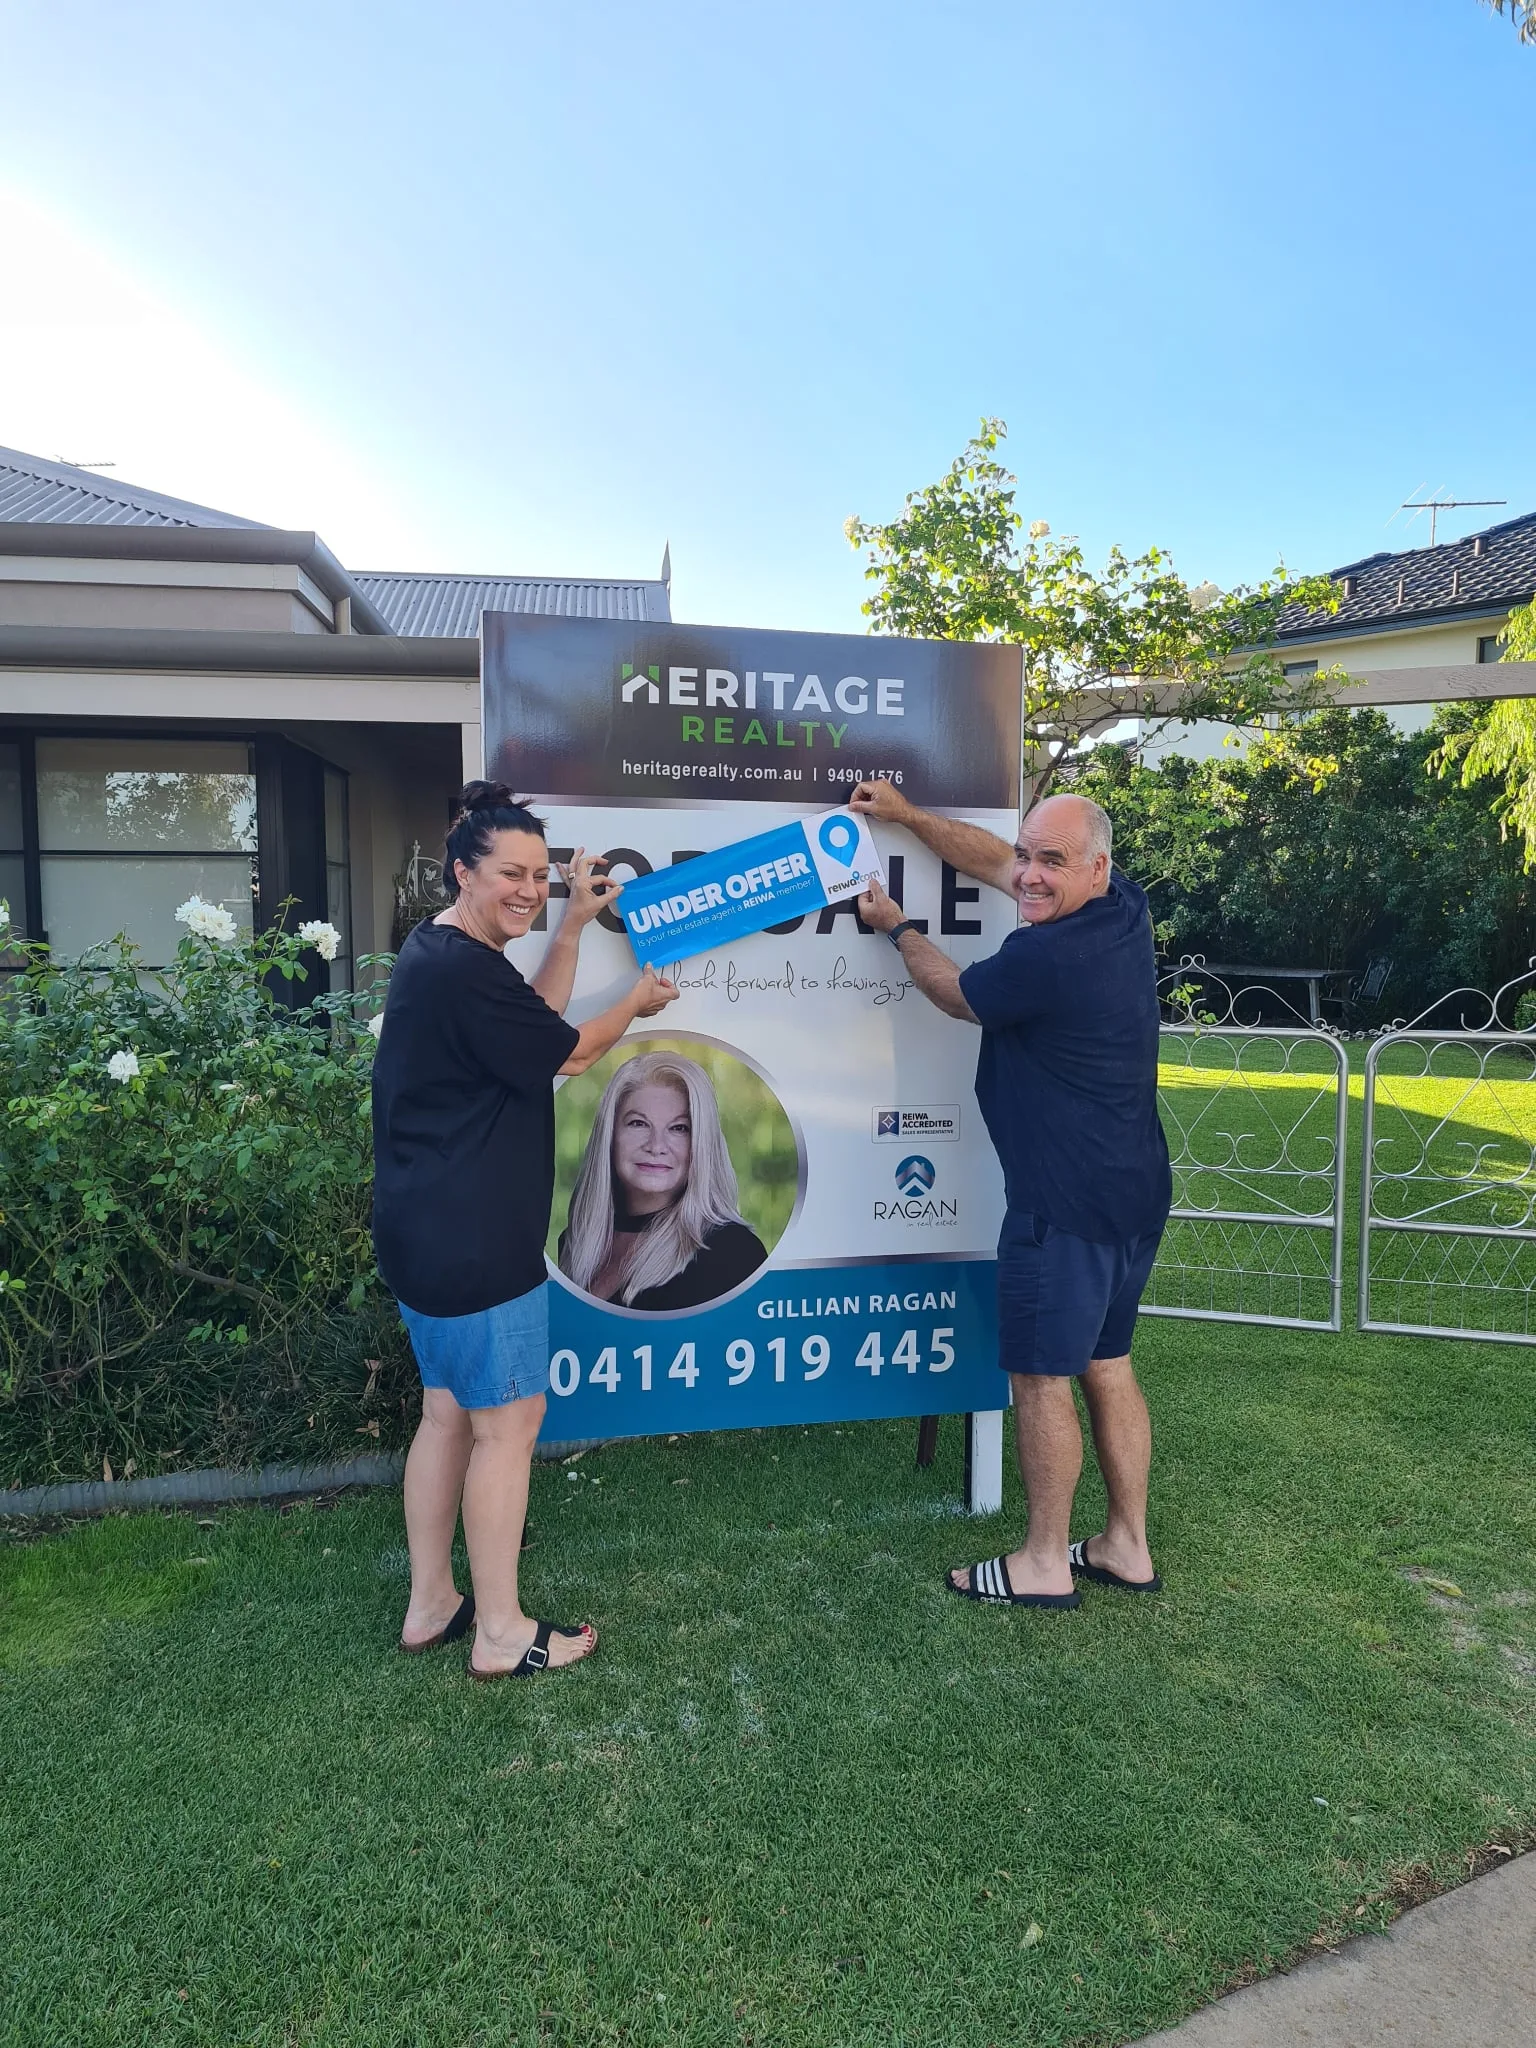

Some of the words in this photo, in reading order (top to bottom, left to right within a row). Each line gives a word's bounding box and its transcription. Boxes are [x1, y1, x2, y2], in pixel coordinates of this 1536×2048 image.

[621, 664, 905, 716] HERITAGE
[681, 715, 848, 749] REALTY
[621, 759, 802, 782] heritagerealty.com.au
[827, 767, 863, 783] 9490
[869, 769, 904, 785] 1576
[530, 847, 708, 933] FO
[628, 883, 727, 934] UNDER
[725, 852, 812, 899] OFFER
[827, 869, 881, 895] reiwa.com
[646, 932, 665, 947] your
[667, 924, 682, 936] real
[684, 915, 710, 931] estate
[711, 905, 736, 921] agent
[743, 891, 776, 909] REIWA
[776, 875, 815, 897] member?
[673, 959, 719, 990] look
[721, 960, 796, 1003] forward
[801, 974, 819, 990] to
[826, 955, 897, 1005] showing
[902, 1120, 953, 1128] ACCREDITED
[874, 1199, 957, 1220] RAGAN
[757, 1295, 861, 1320] GILLIAN
[869, 1291, 957, 1314] RAGAN
[549, 1342, 700, 1397] 0414
[725, 1335, 831, 1386] 919
[855, 1327, 956, 1377] 445
